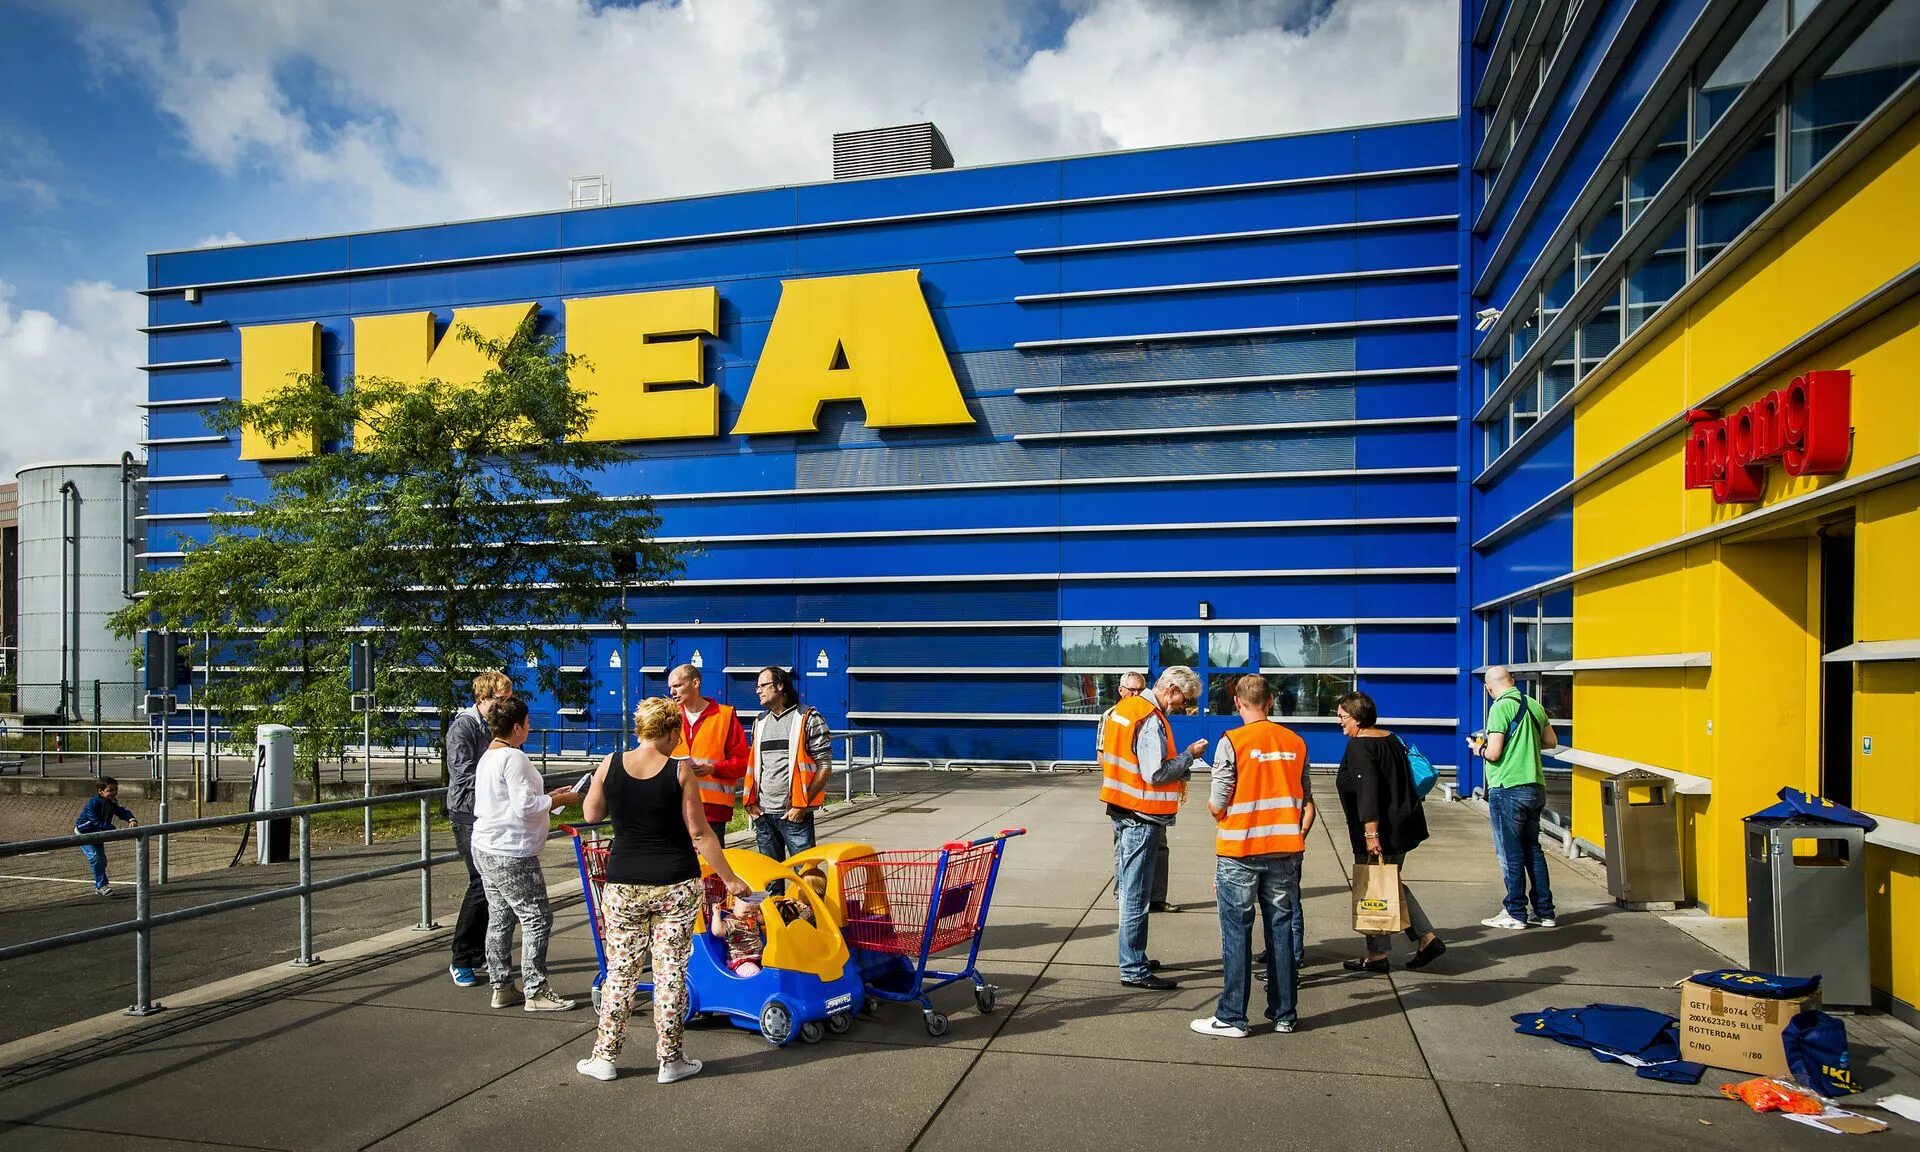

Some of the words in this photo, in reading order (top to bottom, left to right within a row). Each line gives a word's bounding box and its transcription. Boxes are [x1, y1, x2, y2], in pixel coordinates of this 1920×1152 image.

[238, 269, 976, 462] IKEA
[1688, 1025, 1741, 1041] ROTTERDAM
[1740, 1022, 1764, 1032] BLUE
